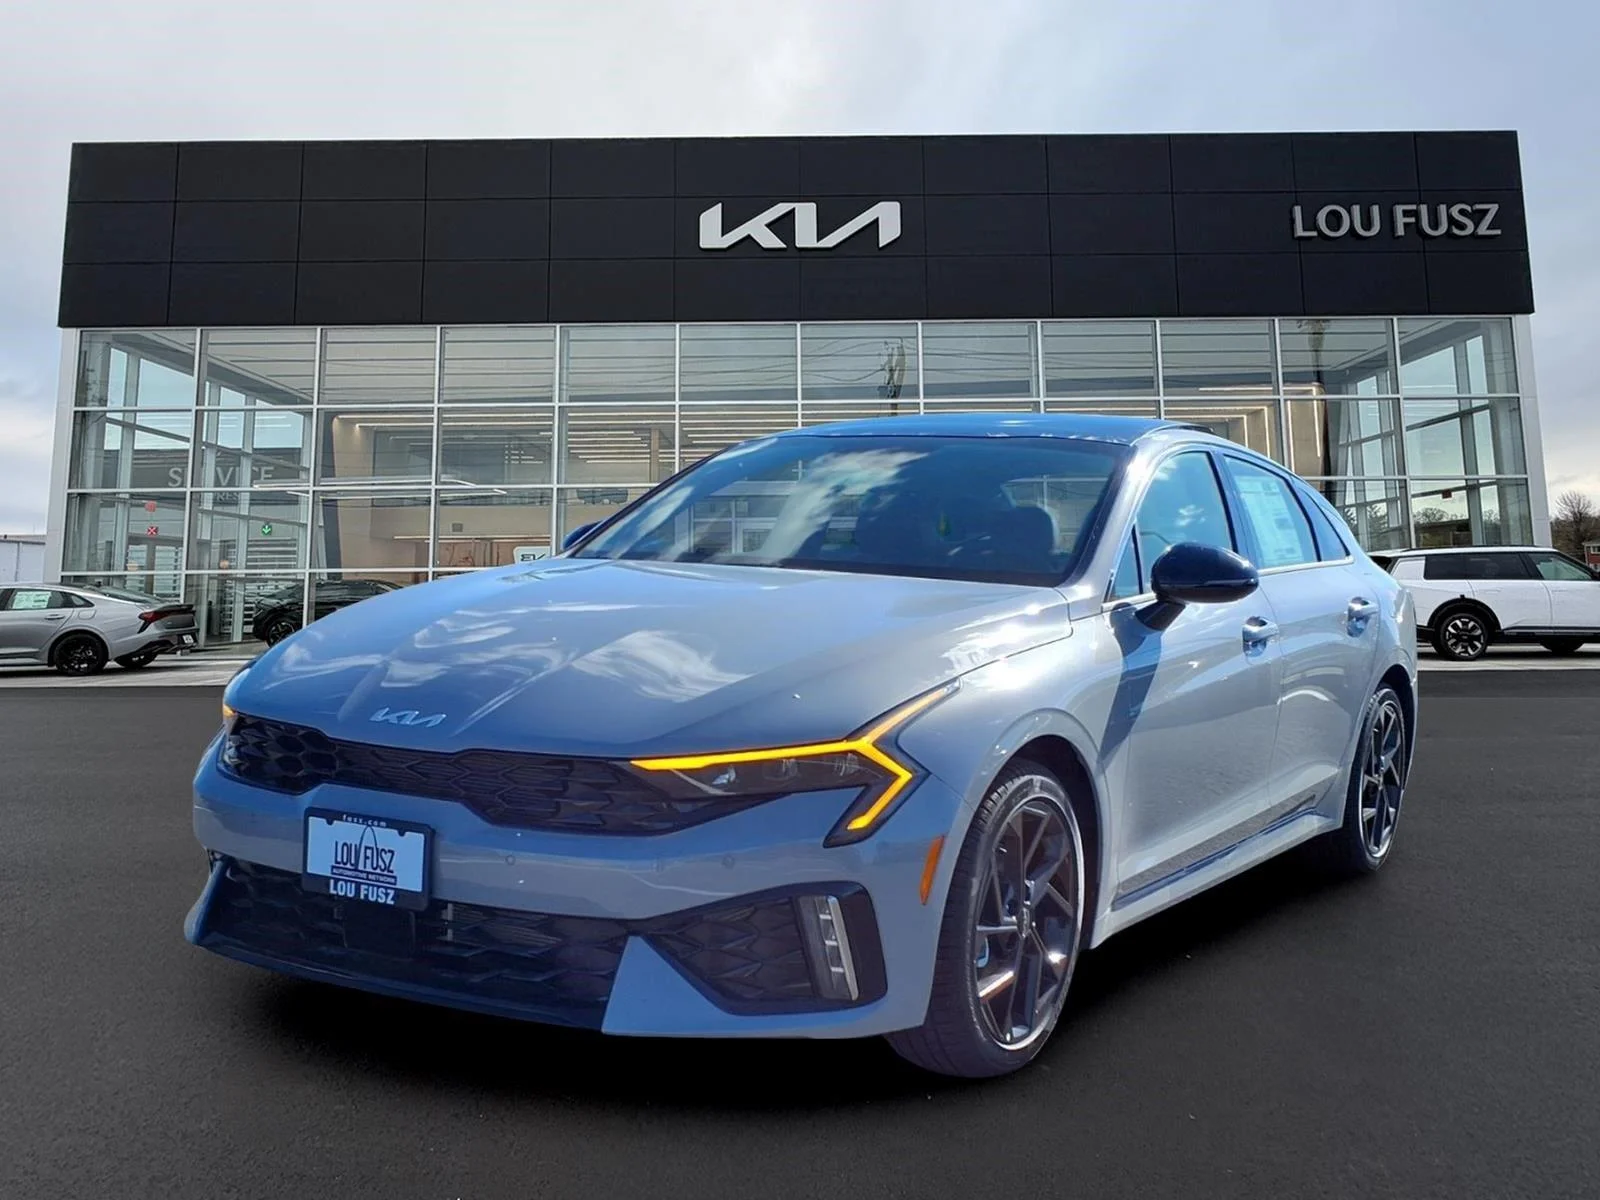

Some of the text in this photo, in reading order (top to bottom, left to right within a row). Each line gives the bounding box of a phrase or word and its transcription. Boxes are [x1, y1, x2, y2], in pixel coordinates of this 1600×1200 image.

[699, 202, 901, 249] KIA
[1293, 203, 1502, 238] LOU FUSZ
[369, 706, 447, 728] KIA
[334, 841, 395, 874] LOU FUSZ
[329, 879, 395, 905] LOU FUSZ
